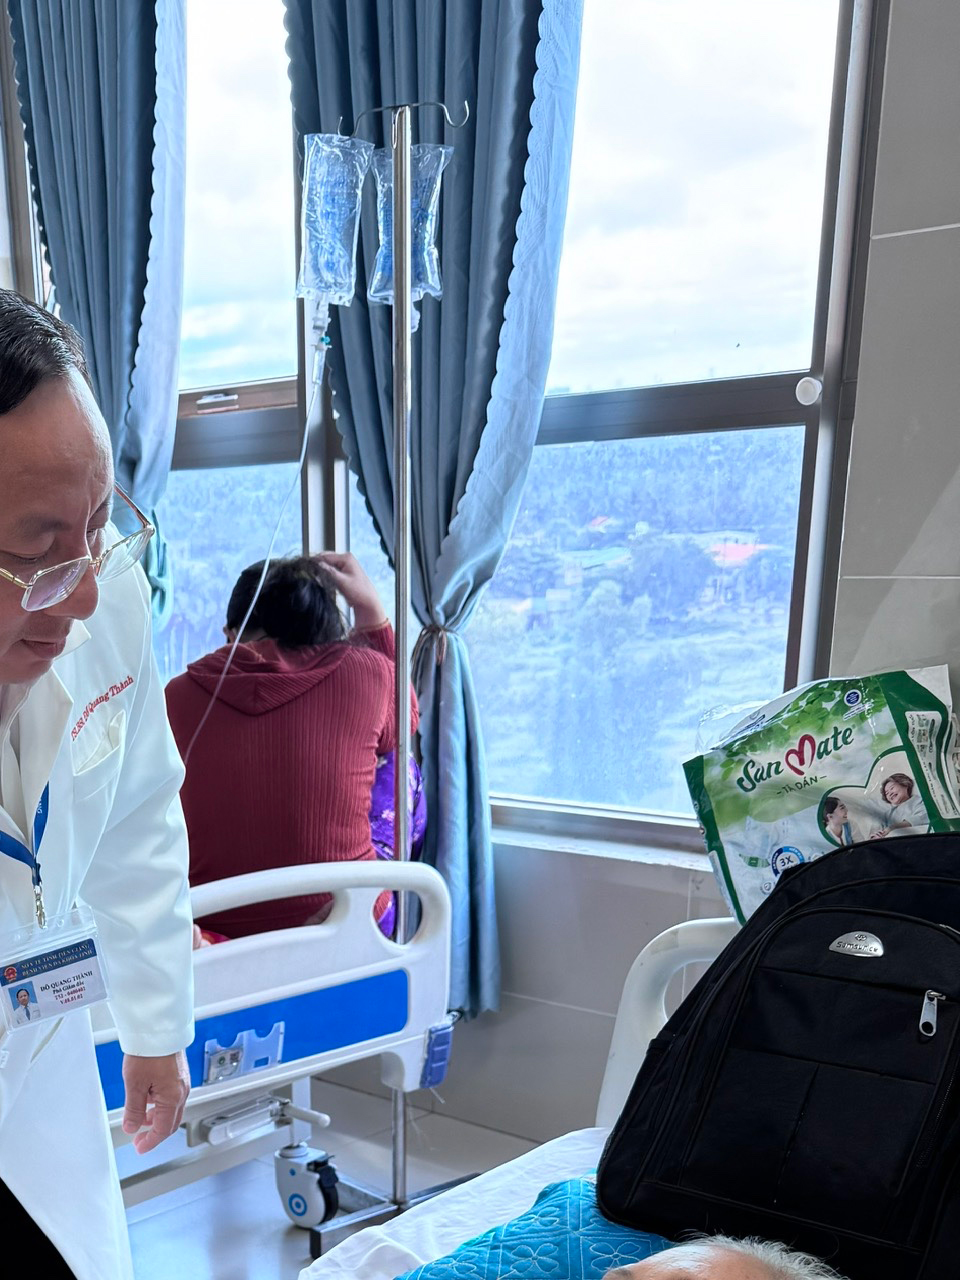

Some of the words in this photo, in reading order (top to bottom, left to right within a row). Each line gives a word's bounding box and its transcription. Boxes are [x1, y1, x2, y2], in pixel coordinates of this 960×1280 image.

[795, 775, 818, 790] DÁN
[780, 855, 794, 867] 3X
[51, 978, 72, 990] QUANG
[73, 971, 93, 982] THÀNH
